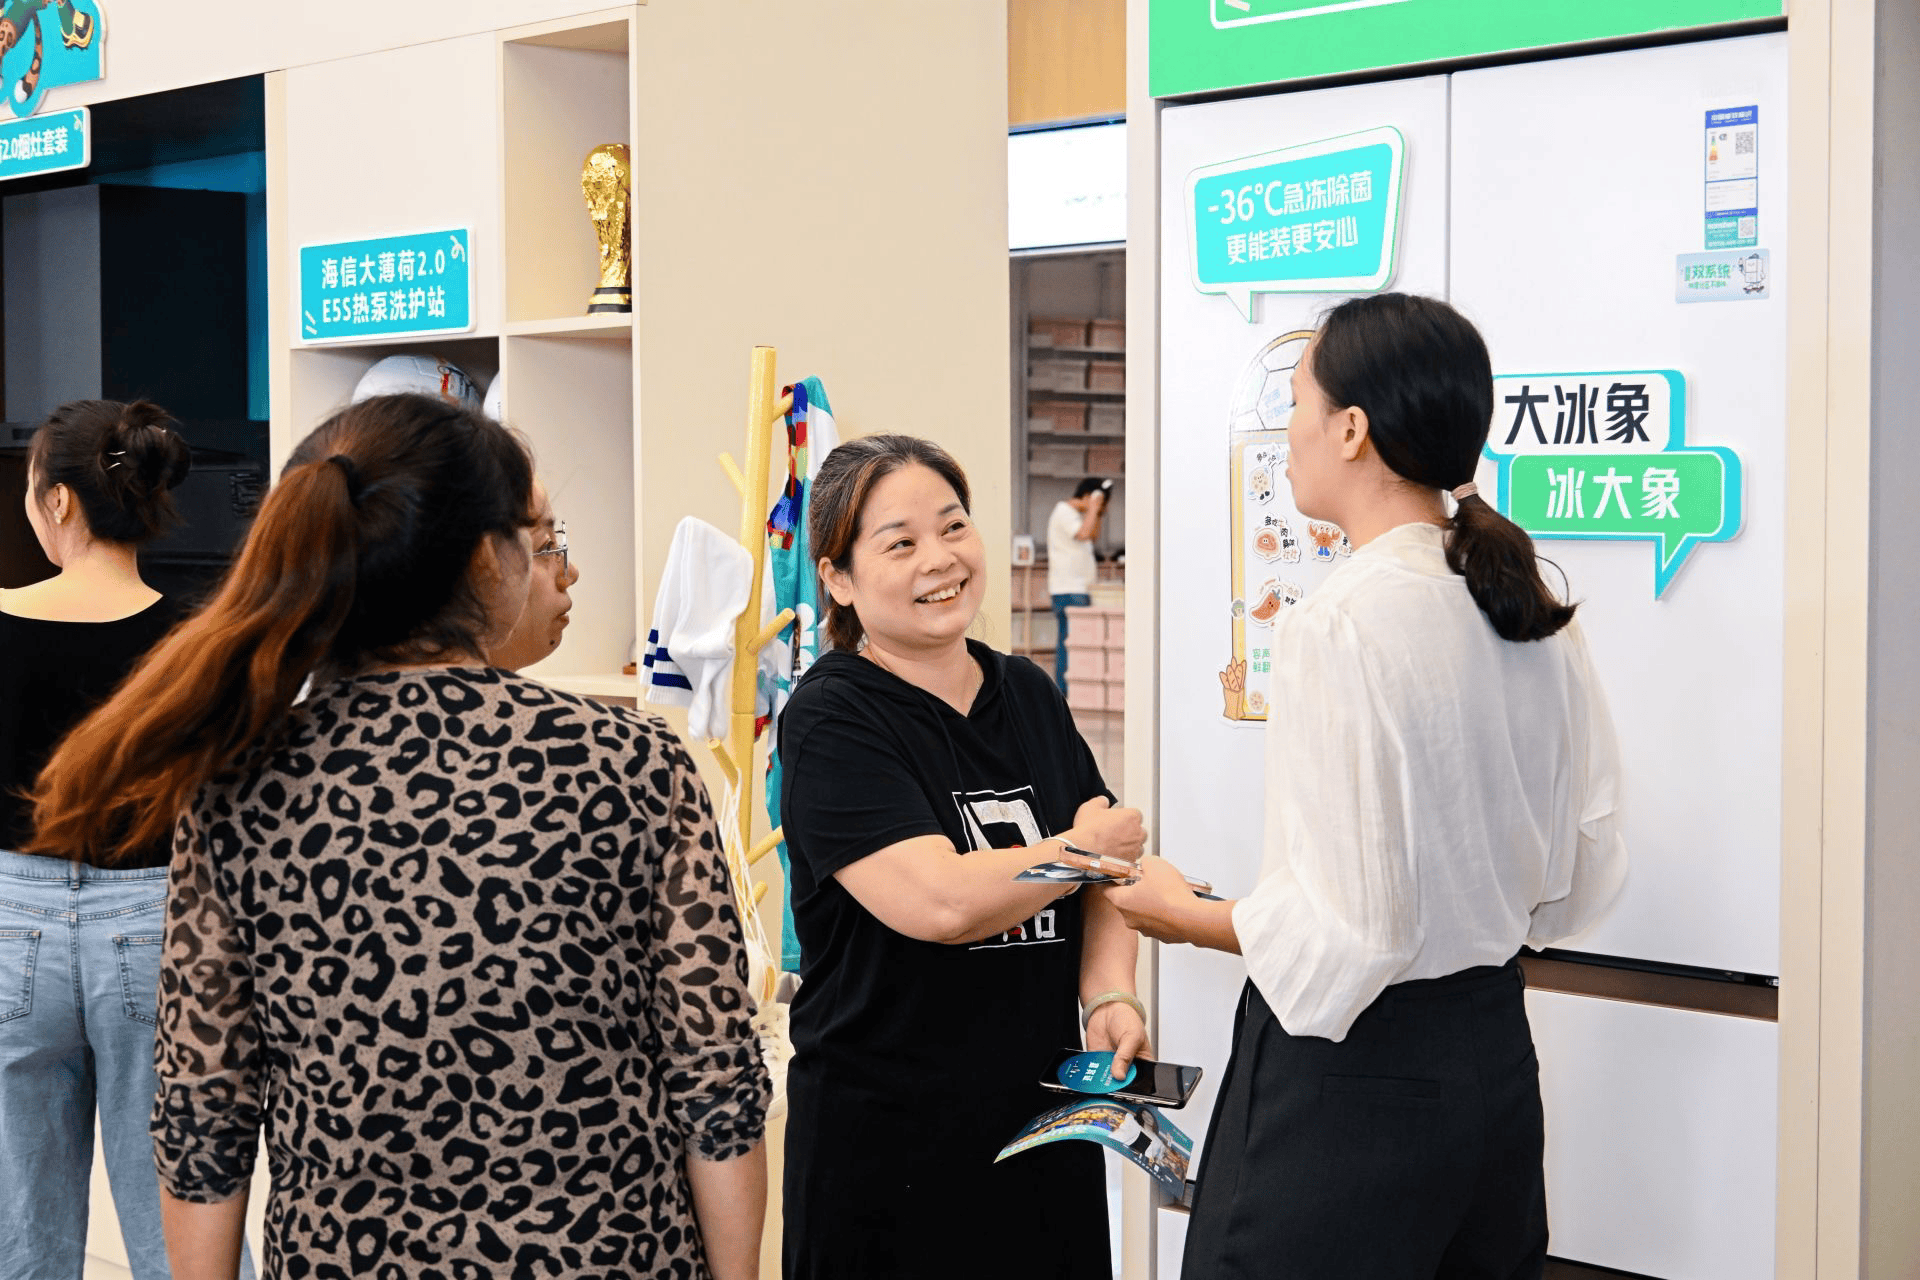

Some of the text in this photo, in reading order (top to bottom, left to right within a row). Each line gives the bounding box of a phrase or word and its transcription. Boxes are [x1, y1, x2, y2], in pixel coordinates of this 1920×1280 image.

[0, 126, 69, 164] 2.0烟灶套装
[1226, 215, 1359, 265] 更能装更安心
[321, 248, 446, 289] 海信大薄荷2.0
[322, 285, 446, 324] E5S热泵洗护站
[1504, 382, 1651, 445] 大冰象
[1546, 466, 1681, 519] 冰大象
